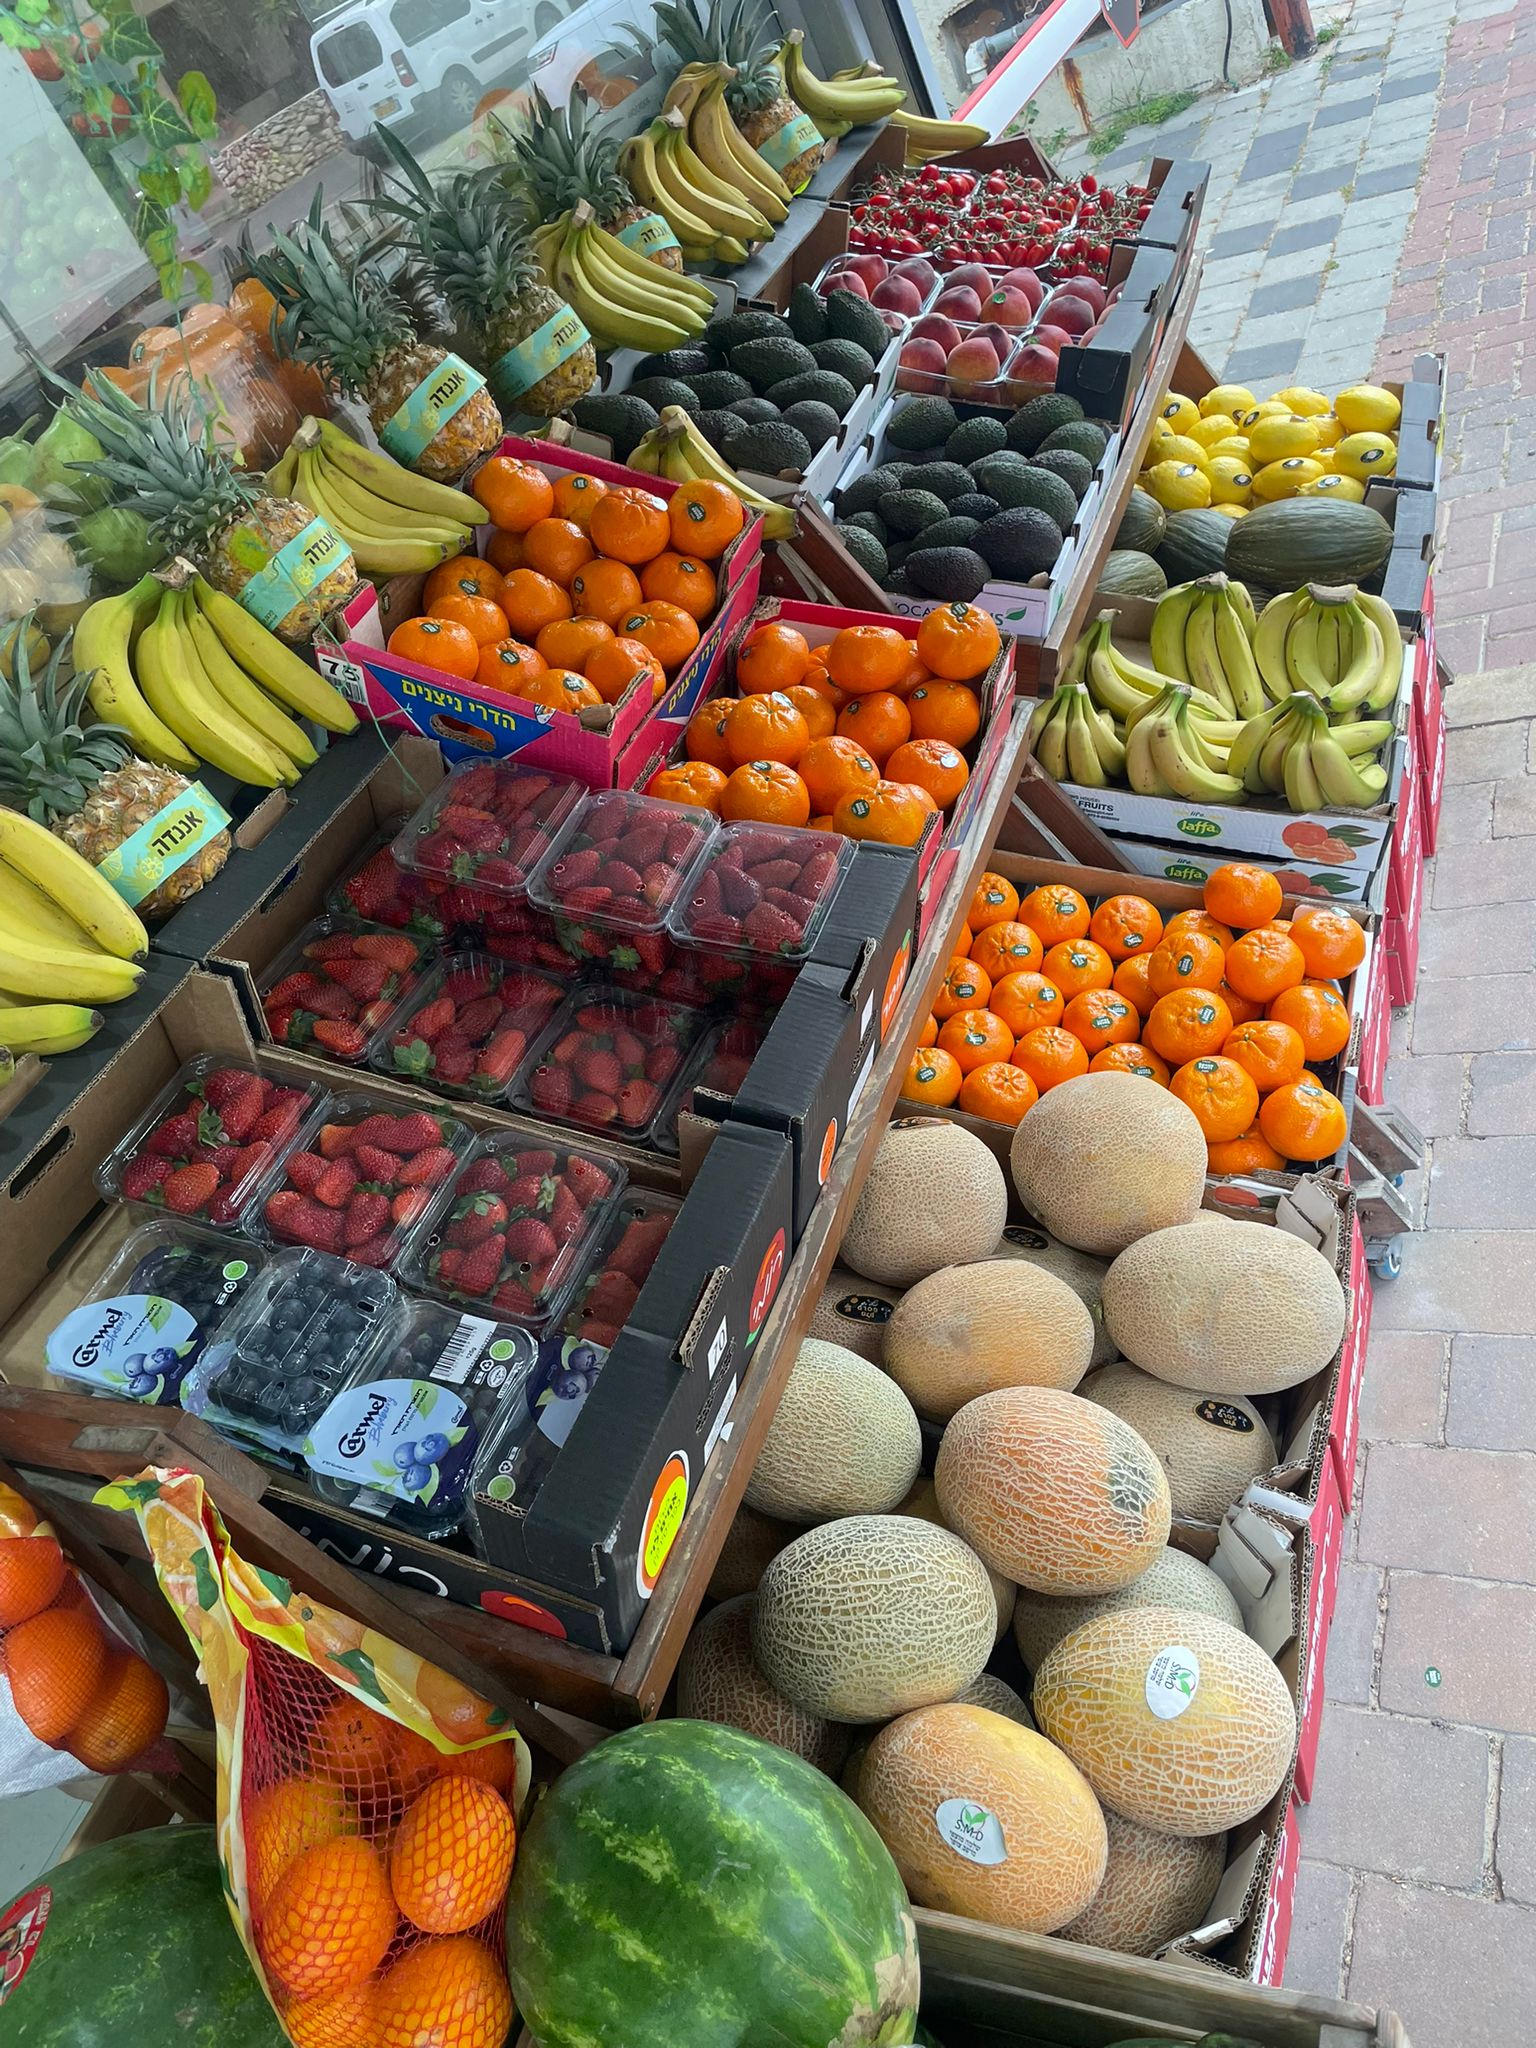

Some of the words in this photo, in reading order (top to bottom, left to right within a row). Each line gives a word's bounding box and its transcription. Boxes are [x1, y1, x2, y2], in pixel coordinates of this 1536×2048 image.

[553, 318, 580, 347] אננדה
[429, 370, 466, 409] אננדה
[304, 530, 338, 565] אננדה
[401, 679, 464, 713] ניצנים
[469, 702, 517, 732] הדרי
[1078, 800, 1114, 812] FRUITS
[152, 811, 203, 857] אננדה
[1181, 820, 1216, 834] Jaffa
[1169, 867, 1203, 880] Jaffa
[72, 1307, 123, 1368] Carmel
[338, 1392, 388, 1459] Carmel
[1164, 1661, 1182, 1690] S.M.D
[954, 1819, 984, 1841] S.M.D
